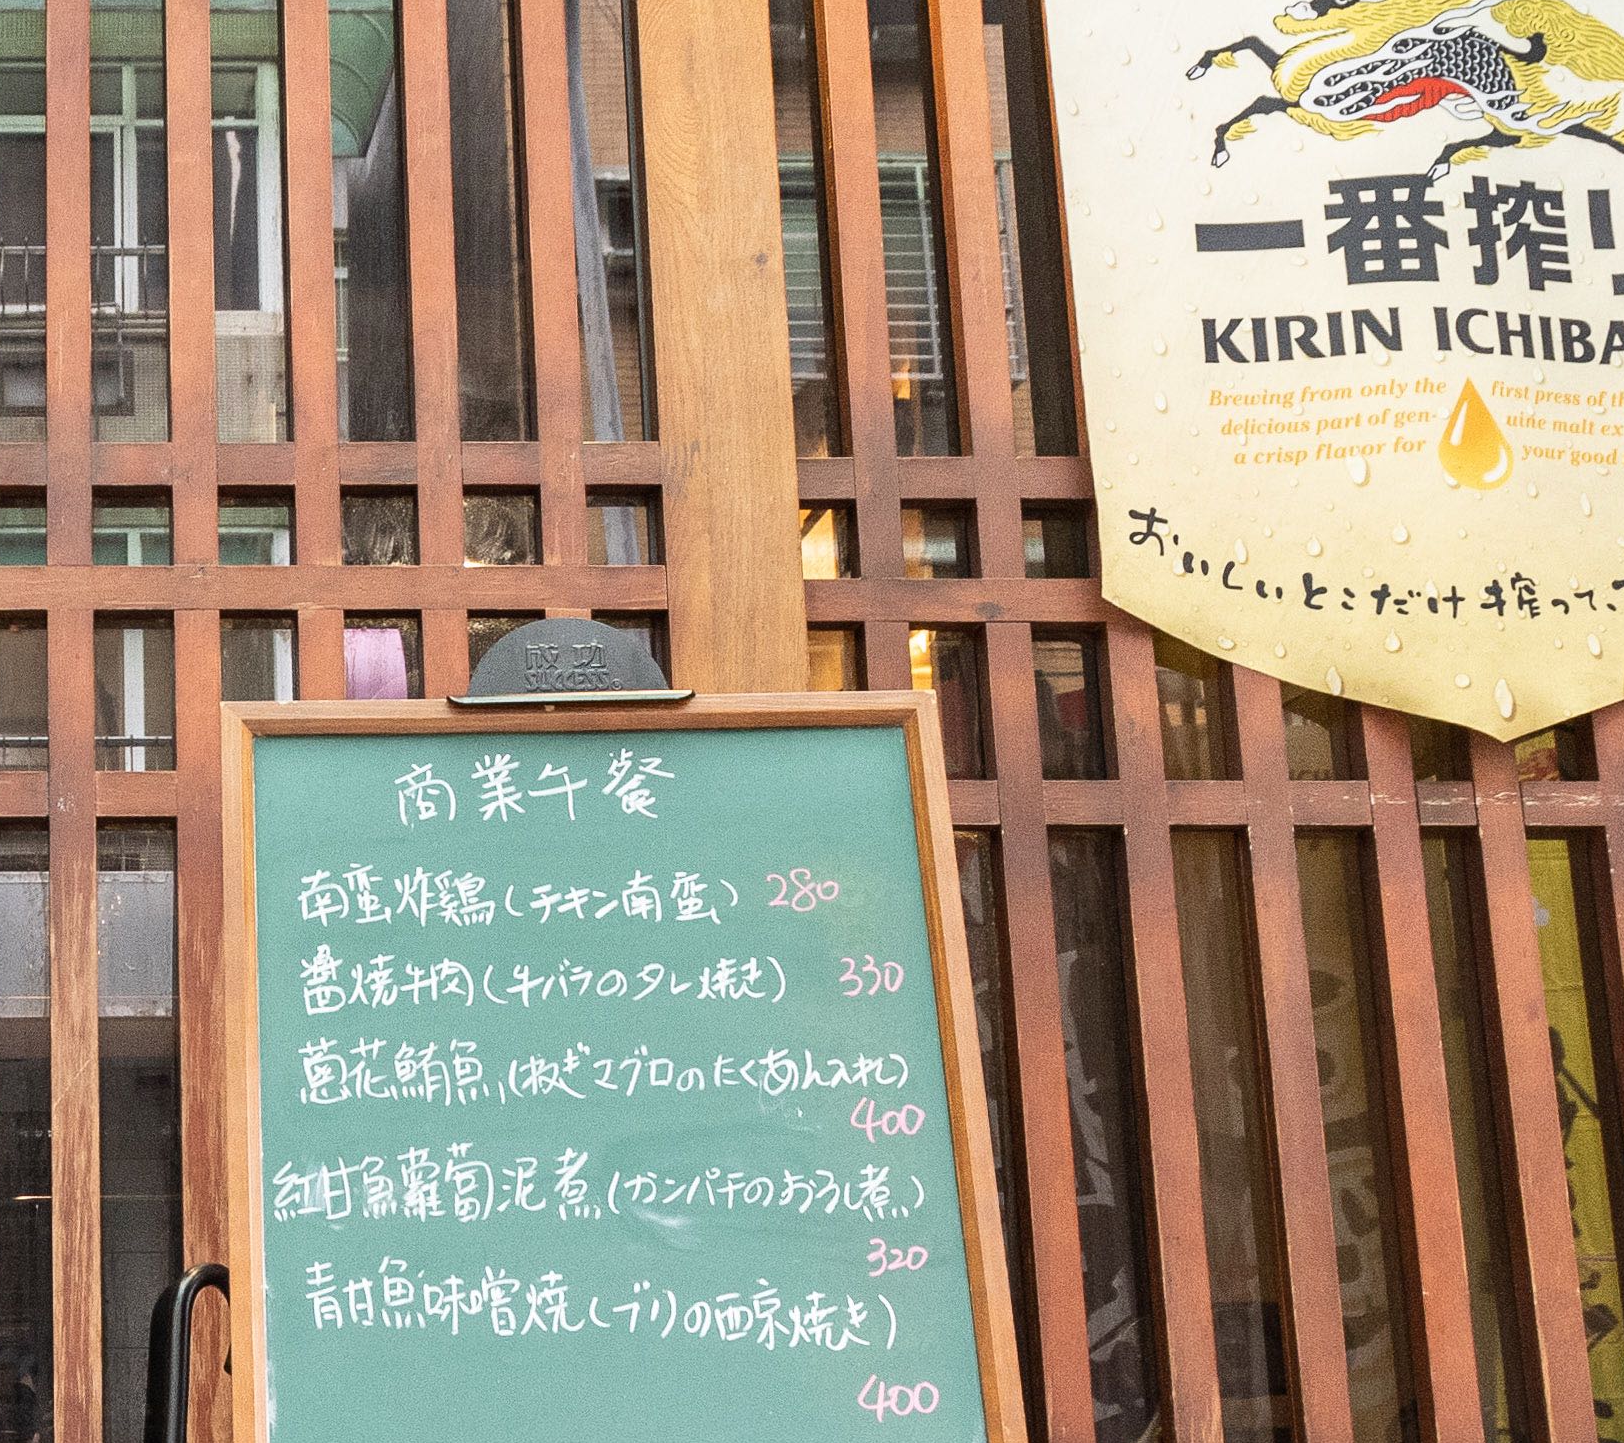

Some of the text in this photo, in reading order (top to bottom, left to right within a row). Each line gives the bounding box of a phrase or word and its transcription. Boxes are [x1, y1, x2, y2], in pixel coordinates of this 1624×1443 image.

[1202, 307, 1403, 364] KIRIN
[1209, 389, 1295, 409] Brewing
[1300, 383, 1352, 407] from
[1360, 380, 1406, 400] only
[1414, 377, 1447, 395] the
[1491, 380, 1530, 400] first
[1534, 391, 1578, 408] press
[1586, 391, 1607, 408] of
[1221, 416, 1311, 437] delicious
[1316, 412, 1362, 434] part
[1368, 408, 1389, 428] of
[1393, 409, 1437, 431] gen-
[1506, 412, 1546, 429] uine
[1552, 418, 1595, 435] malt
[1234, 452, 1247, 466] a
[1253, 445, 1307, 467] crisp
[1315, 437, 1386, 461] flavor
[1392, 437, 1426, 455] for
[1521, 444, 1565, 463] your
[1570, 446, 1618, 467] good
[394, 748, 675, 826] 商業午餐
[767, 868, 840, 912] 280
[839, 956, 904, 997] 330
[849, 1097, 926, 1144] 400
[865, 1238, 928, 1277] 320
[857, 1373, 940, 1423] 400
